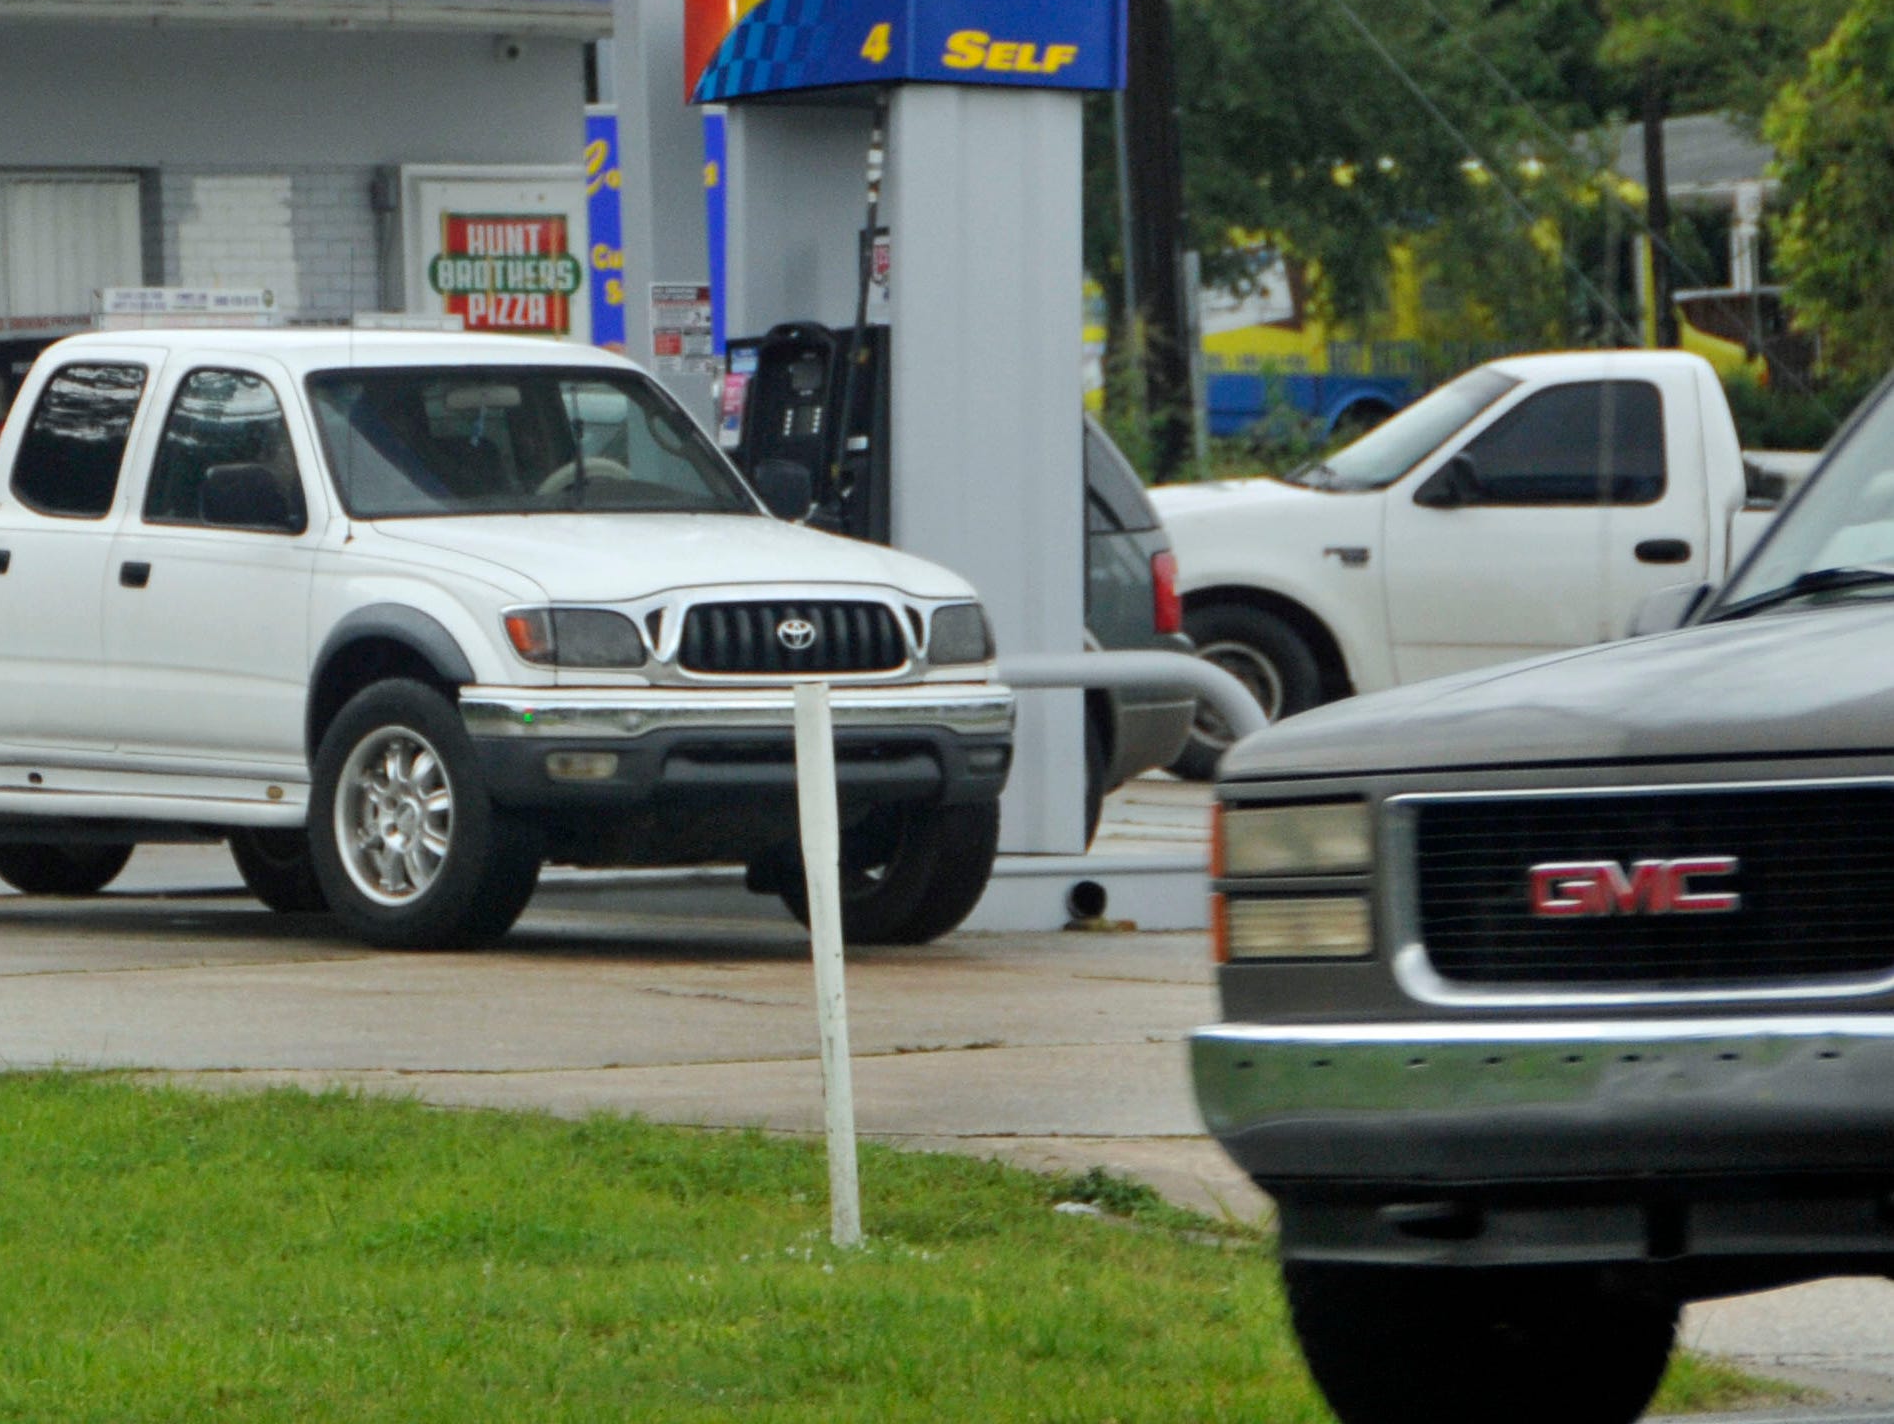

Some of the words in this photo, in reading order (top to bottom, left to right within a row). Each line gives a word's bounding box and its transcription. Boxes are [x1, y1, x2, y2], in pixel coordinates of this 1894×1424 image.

[860, 21, 892, 64] 4
[467, 223, 541, 256] HUNT
[437, 258, 576, 290] BROTHERS
[468, 293, 546, 326] PIZZA
[1528, 856, 1742, 917] GMC
